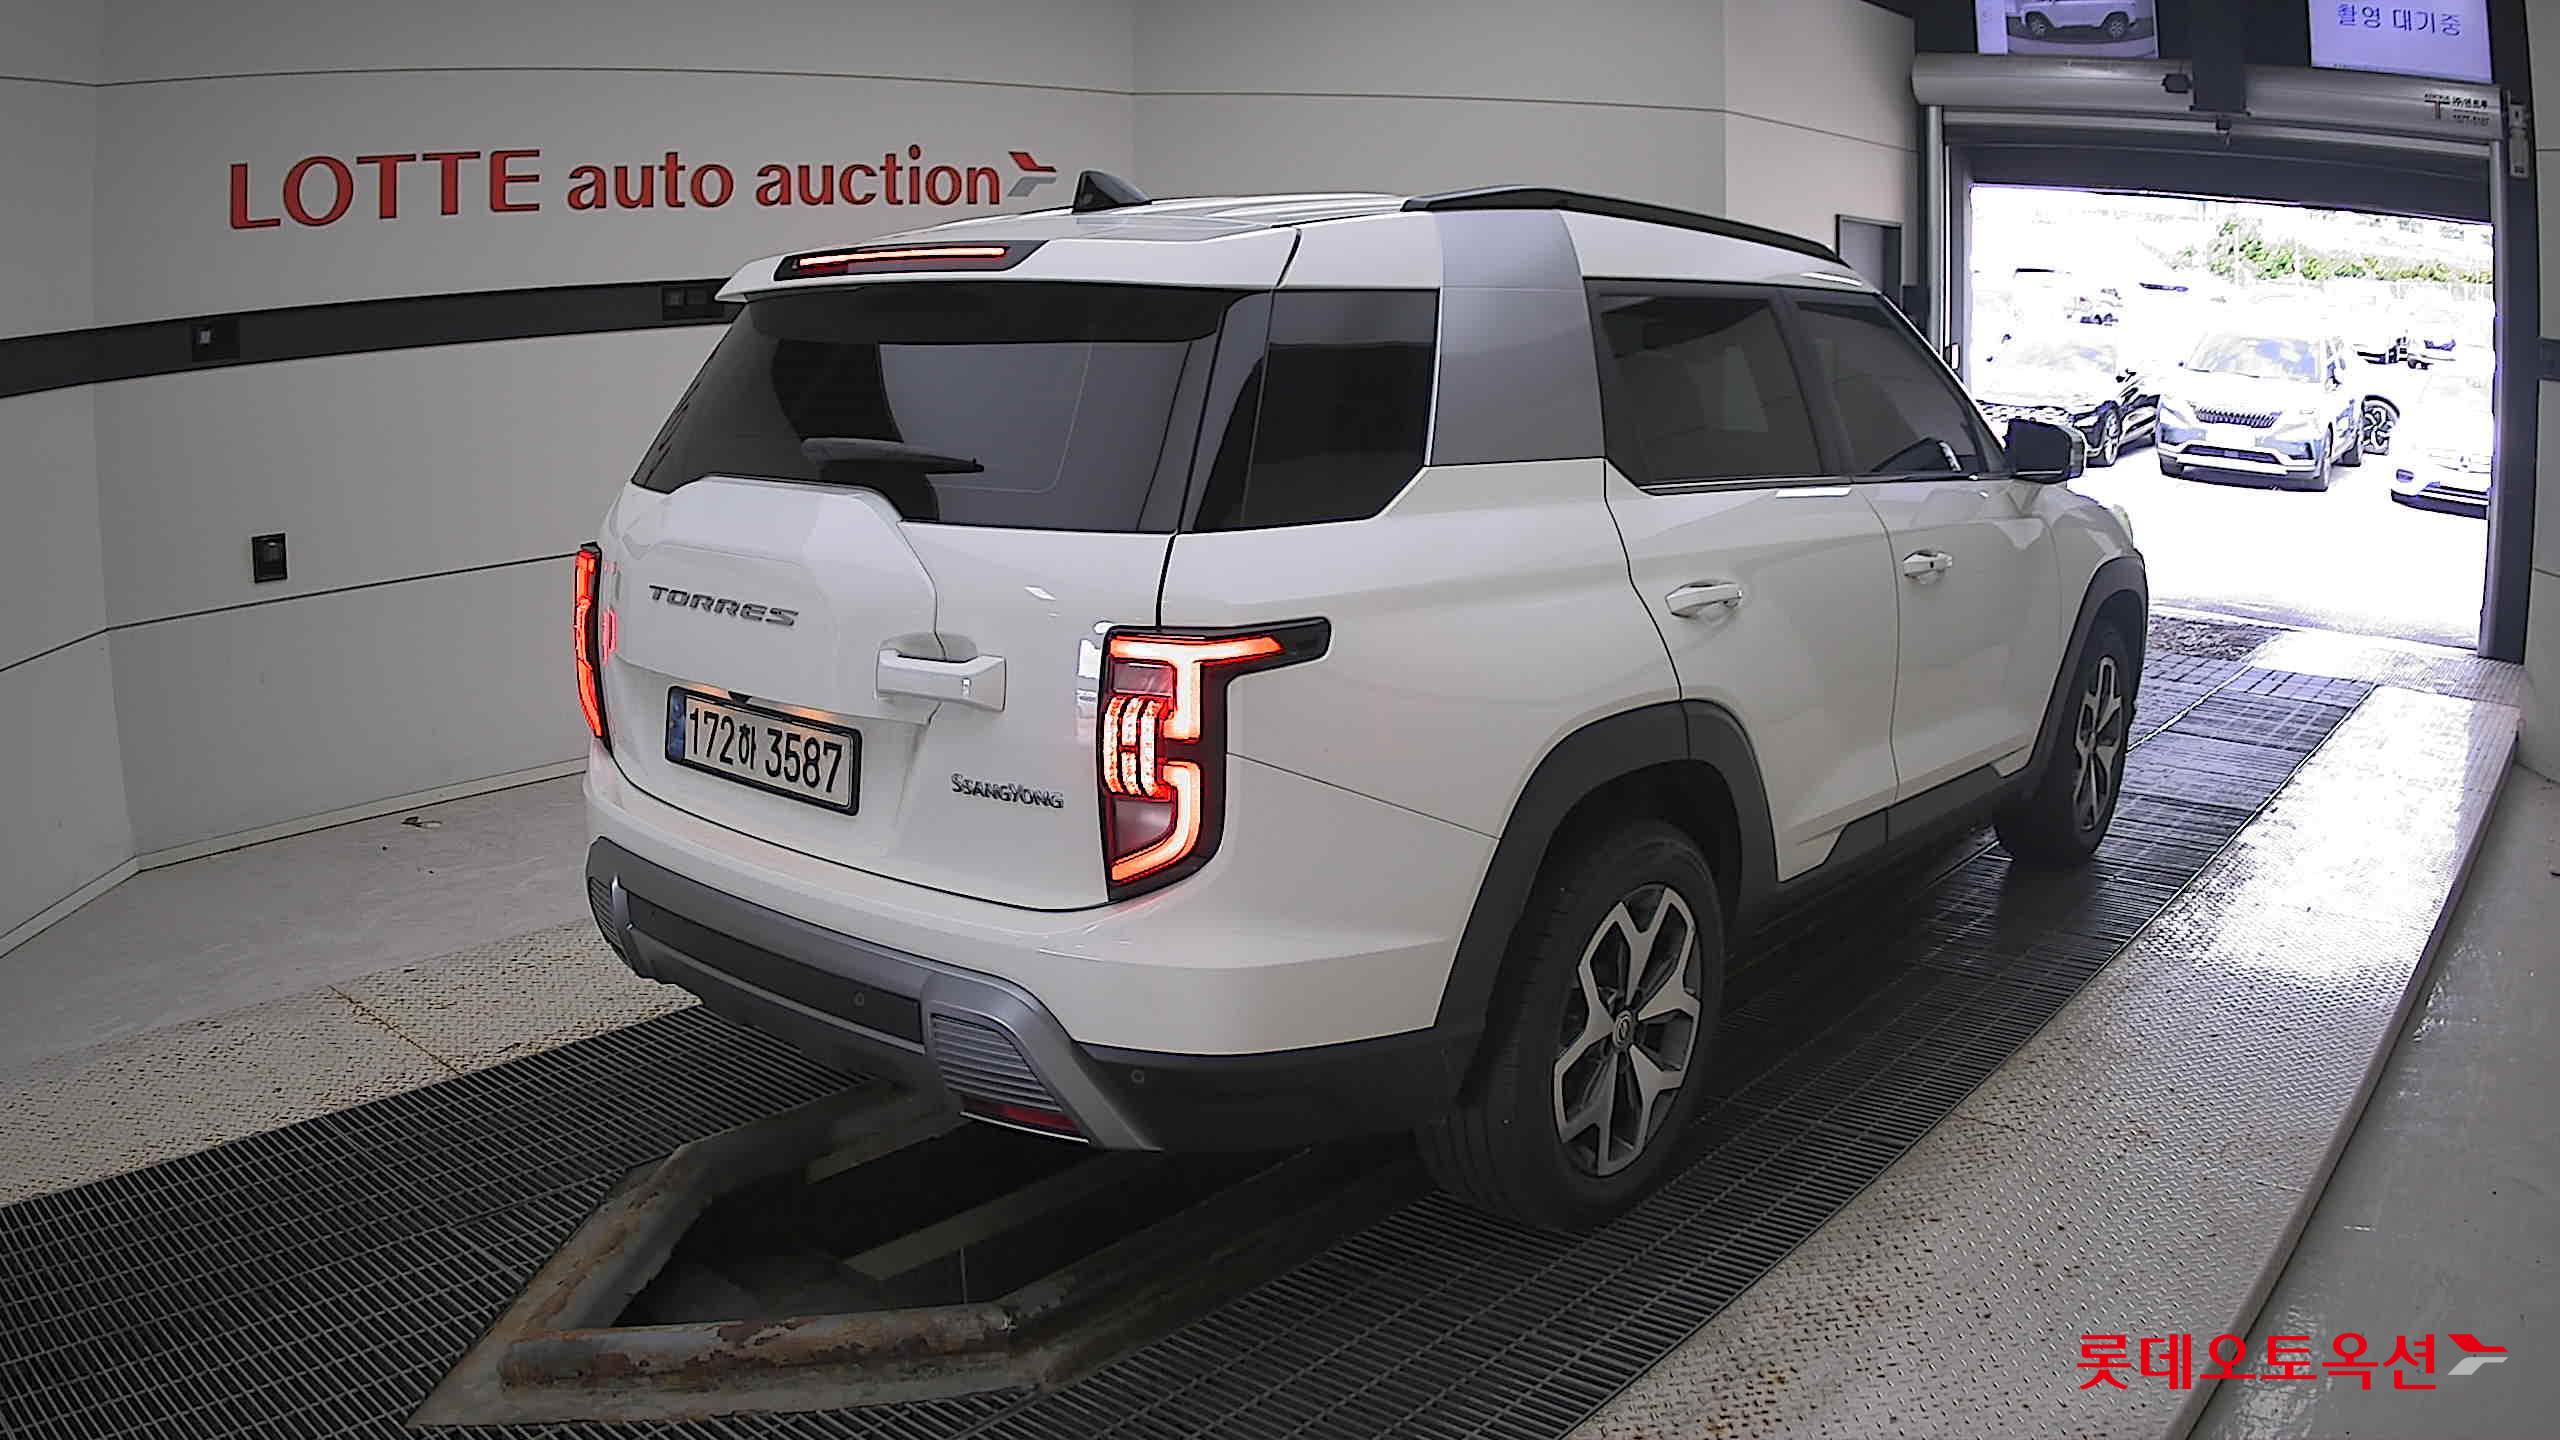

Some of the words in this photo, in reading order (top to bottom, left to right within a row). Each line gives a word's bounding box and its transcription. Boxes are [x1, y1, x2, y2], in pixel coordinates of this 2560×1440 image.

[2393, 9, 2461, 36] 대기중
[229, 150, 541, 230] LOTTE
[566, 152, 734, 210] auto
[755, 145, 1001, 207] auction
[649, 585, 798, 627] TORRES
[690, 708, 756, 770] 172하
[765, 728, 842, 793] 3587
